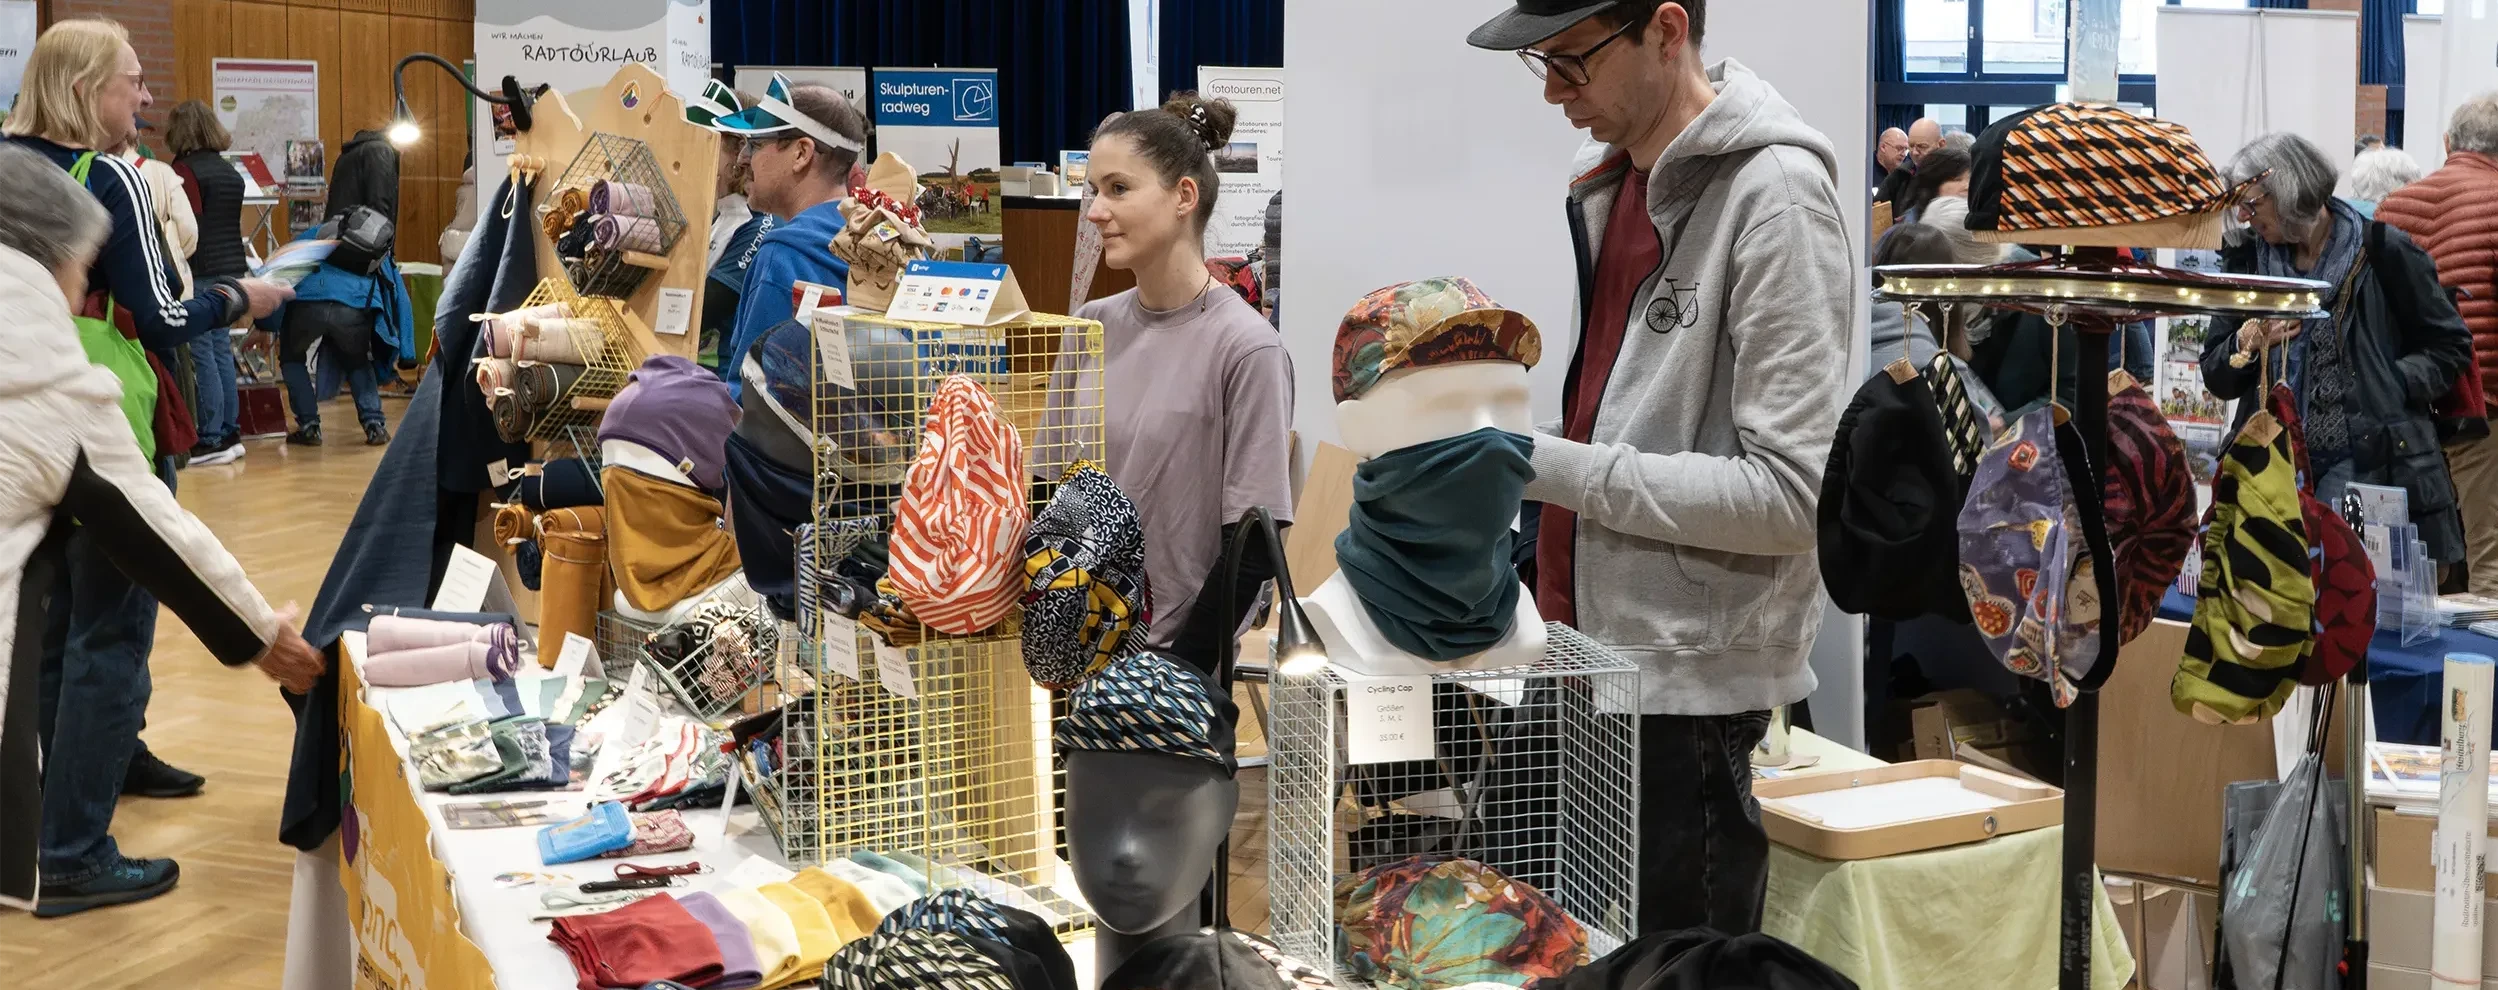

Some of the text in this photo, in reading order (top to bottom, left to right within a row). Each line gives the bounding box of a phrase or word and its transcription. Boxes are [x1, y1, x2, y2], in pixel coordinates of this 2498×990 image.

[491, 32, 544, 41] WIR MACHEN
[879, 82, 950, 98] Skulpturen-
[1211, 84, 1281, 94] fototouren.net
[843, 89, 854, 100] ld
[881, 101, 930, 116] radweg
[1367, 684, 1414, 694] Cycling Cap
[1376, 704, 1405, 713] Größen
[1399, 733, 1405, 741] €
